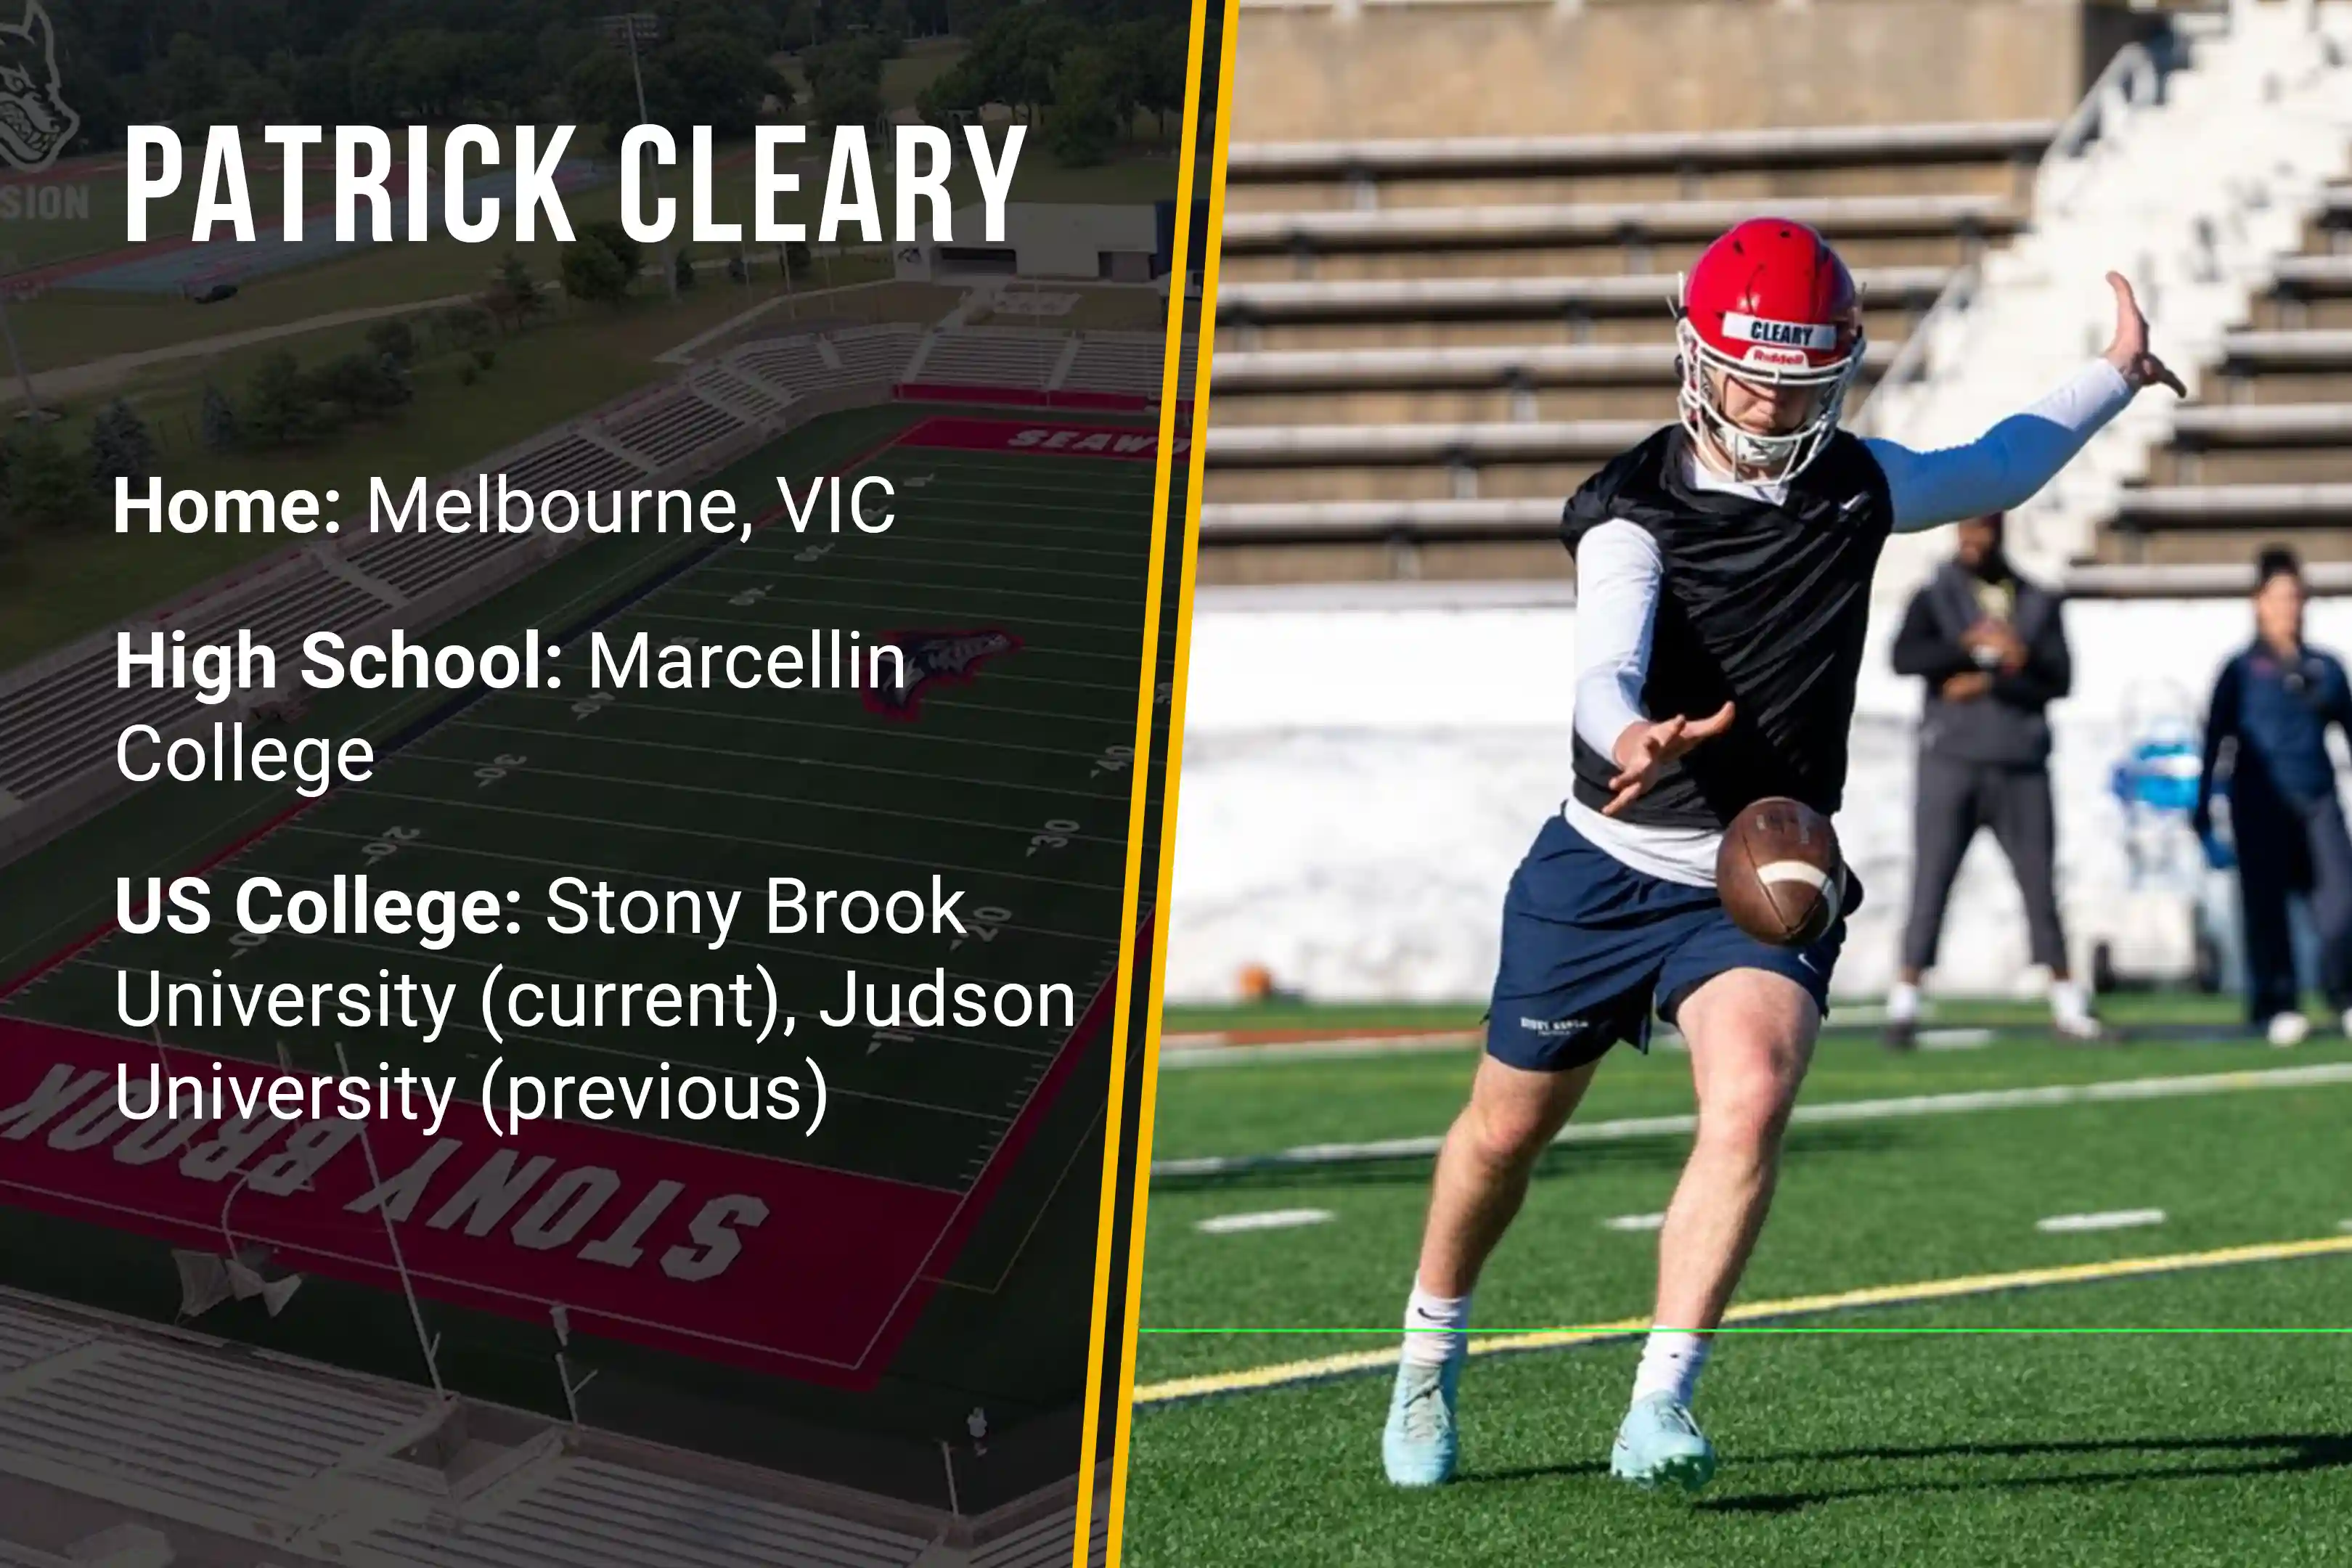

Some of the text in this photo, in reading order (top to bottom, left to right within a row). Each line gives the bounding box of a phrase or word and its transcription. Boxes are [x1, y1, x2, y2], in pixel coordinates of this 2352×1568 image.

[1751, 321, 1813, 346] CLEARY
[0, 1063, 770, 1282] STONY BROOK
